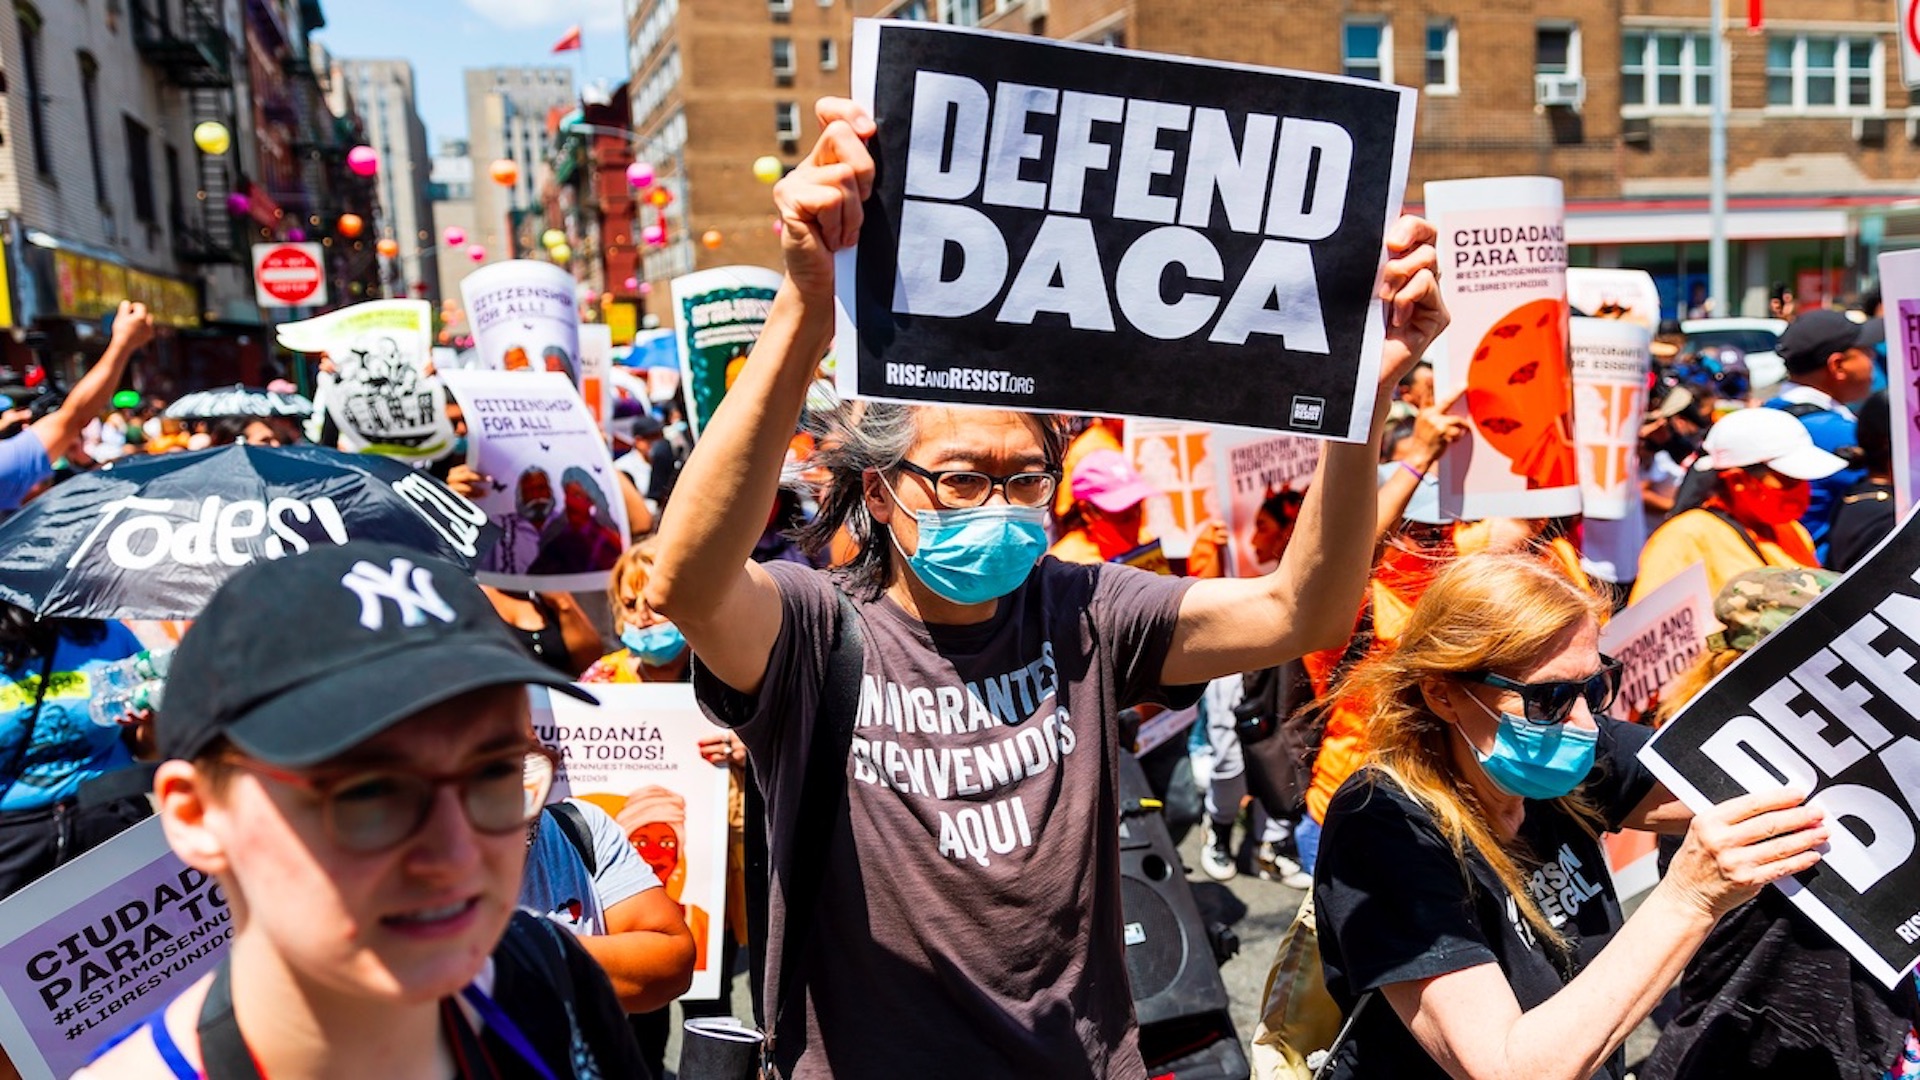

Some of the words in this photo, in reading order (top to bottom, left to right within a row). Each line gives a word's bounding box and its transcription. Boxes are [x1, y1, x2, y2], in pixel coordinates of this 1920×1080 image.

[905, 70, 1354, 241] DEFEND
[891, 199, 1331, 355] DACA
[1455, 248, 1518, 268] PARA
[473, 398, 573, 412] CITIZENSHIP
[886, 362, 1035, 394] RISEANDRESIST.ORG
[482, 416, 515, 431] FOR
[520, 416, 552, 430] ALL!
[341, 557, 457, 631] NY
[583, 745, 664, 760] TODOS!
[852, 706, 1077, 801] BIENVENIDOS
[938, 796, 1032, 867] AQUI
[39, 923, 174, 1012] PARA
